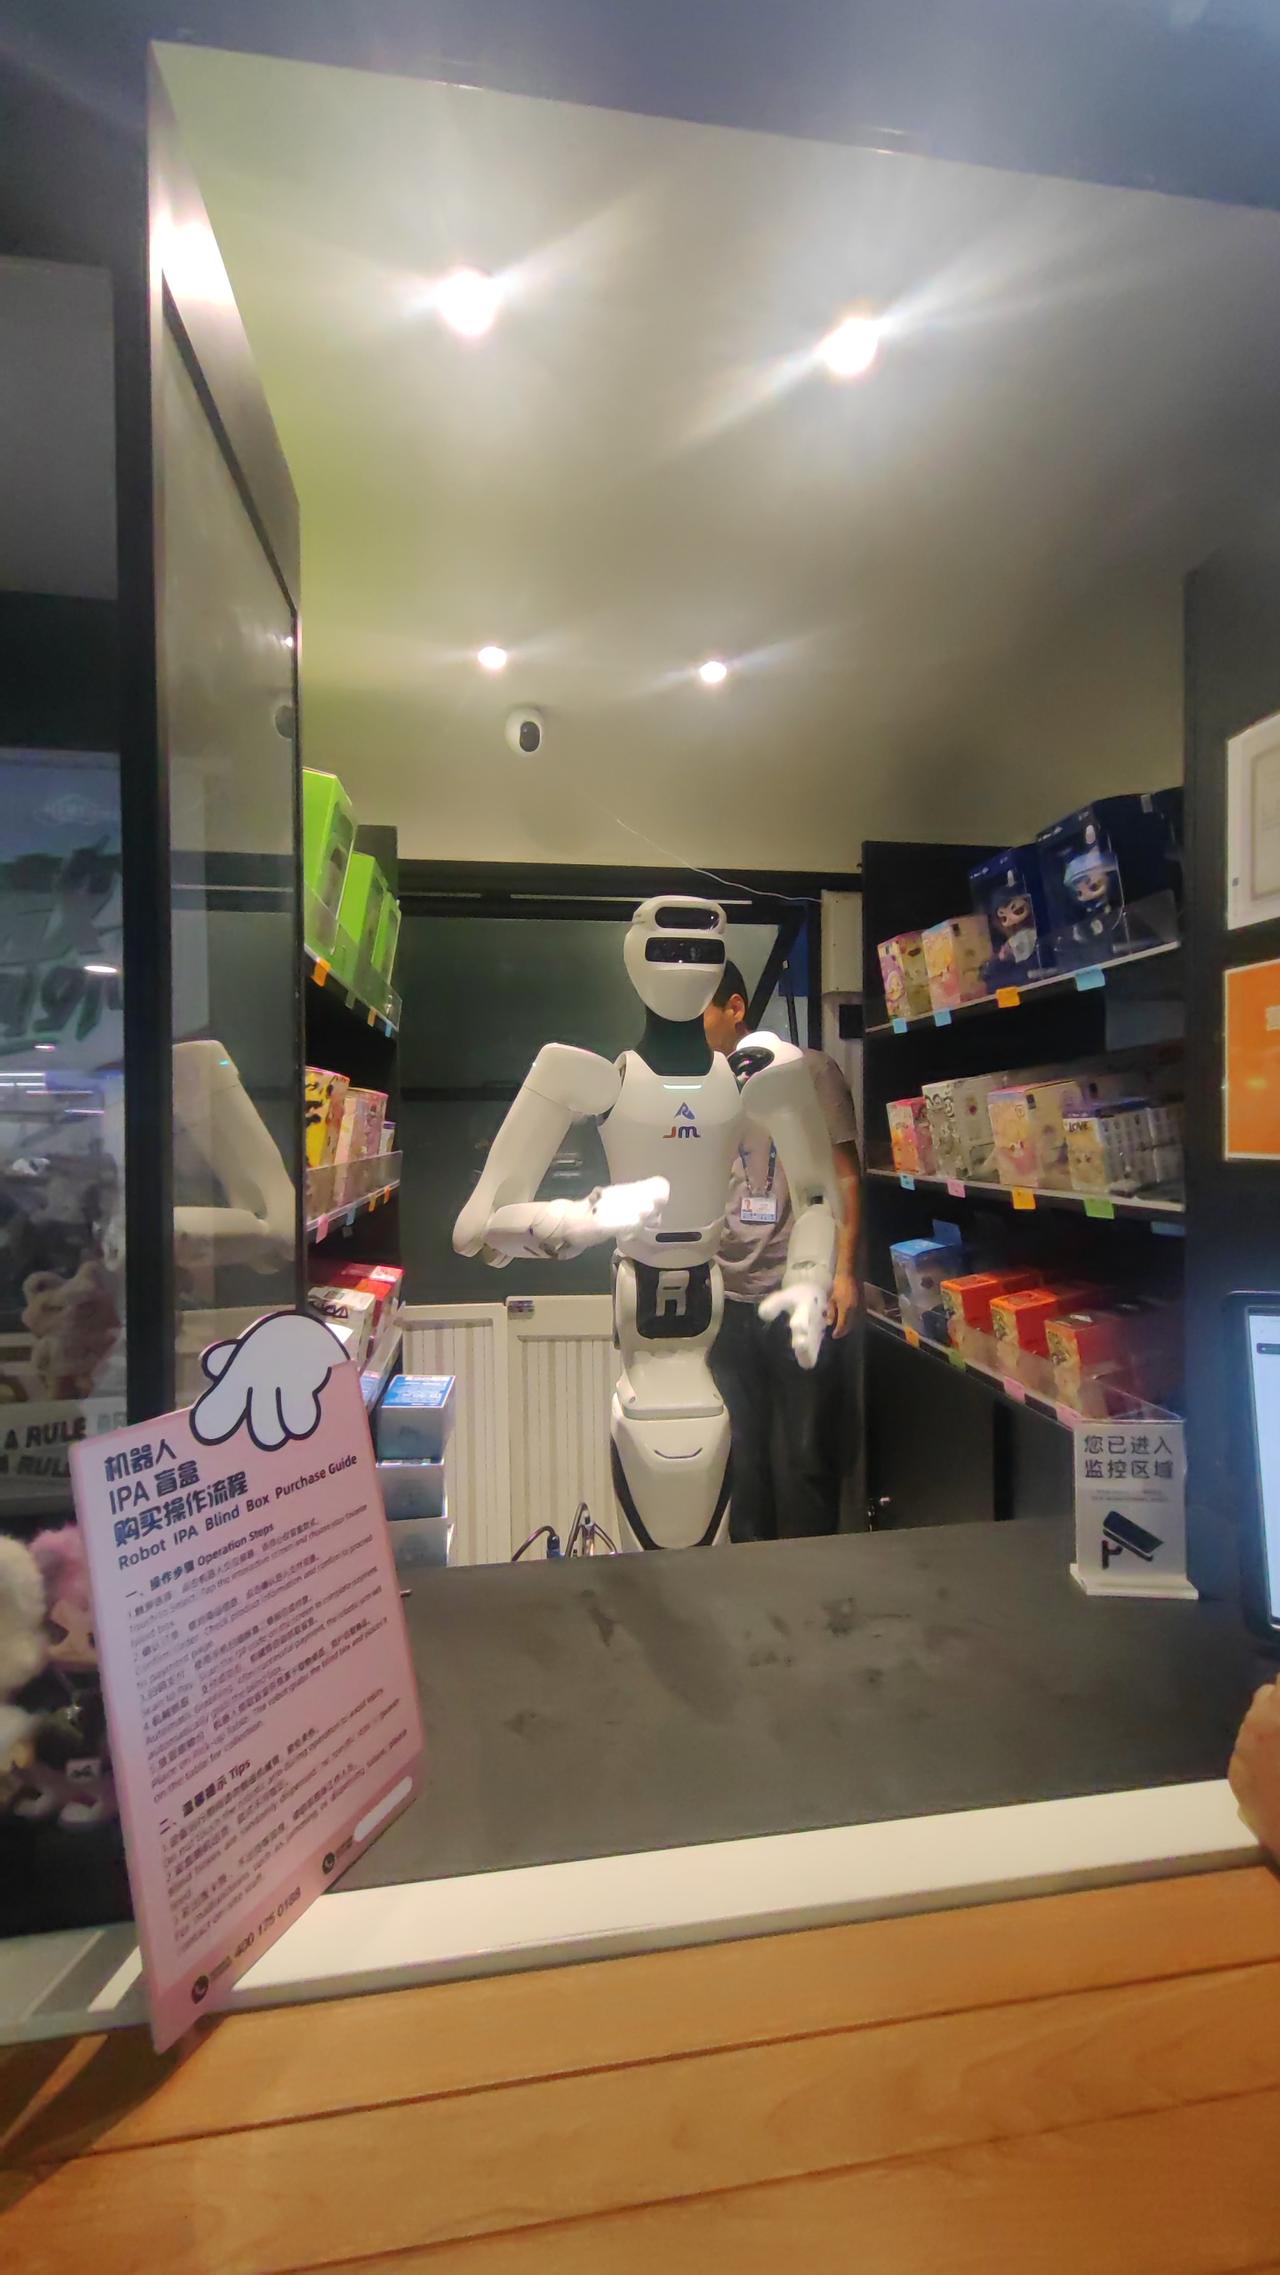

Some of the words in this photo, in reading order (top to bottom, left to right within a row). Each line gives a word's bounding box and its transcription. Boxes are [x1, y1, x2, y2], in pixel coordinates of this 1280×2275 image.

[26, 1415, 87, 1448] RULE
[1083, 1434, 1173, 1455] 您已进入
[103, 1435, 177, 1483] 机器人
[1084, 1459, 1175, 1480] 监控区域
[108, 1477, 150, 1516] IPA
[153, 1458, 200, 1498] 盲盒
[112, 1470, 248, 1549] 购买操作流程
[118, 1537, 166, 1571] Robot
[173, 1523, 198, 1546] IPA
[204, 1505, 240, 1532] Blind
[246, 1492, 269, 1513] Box
[274, 1467, 326, 1499] Purchase
[328, 1453, 357, 1475] Guide
[197, 1534, 247, 1568] Operation
[249, 1521, 273, 1542] Steps
[229, 1754, 250, 1782] Tips
